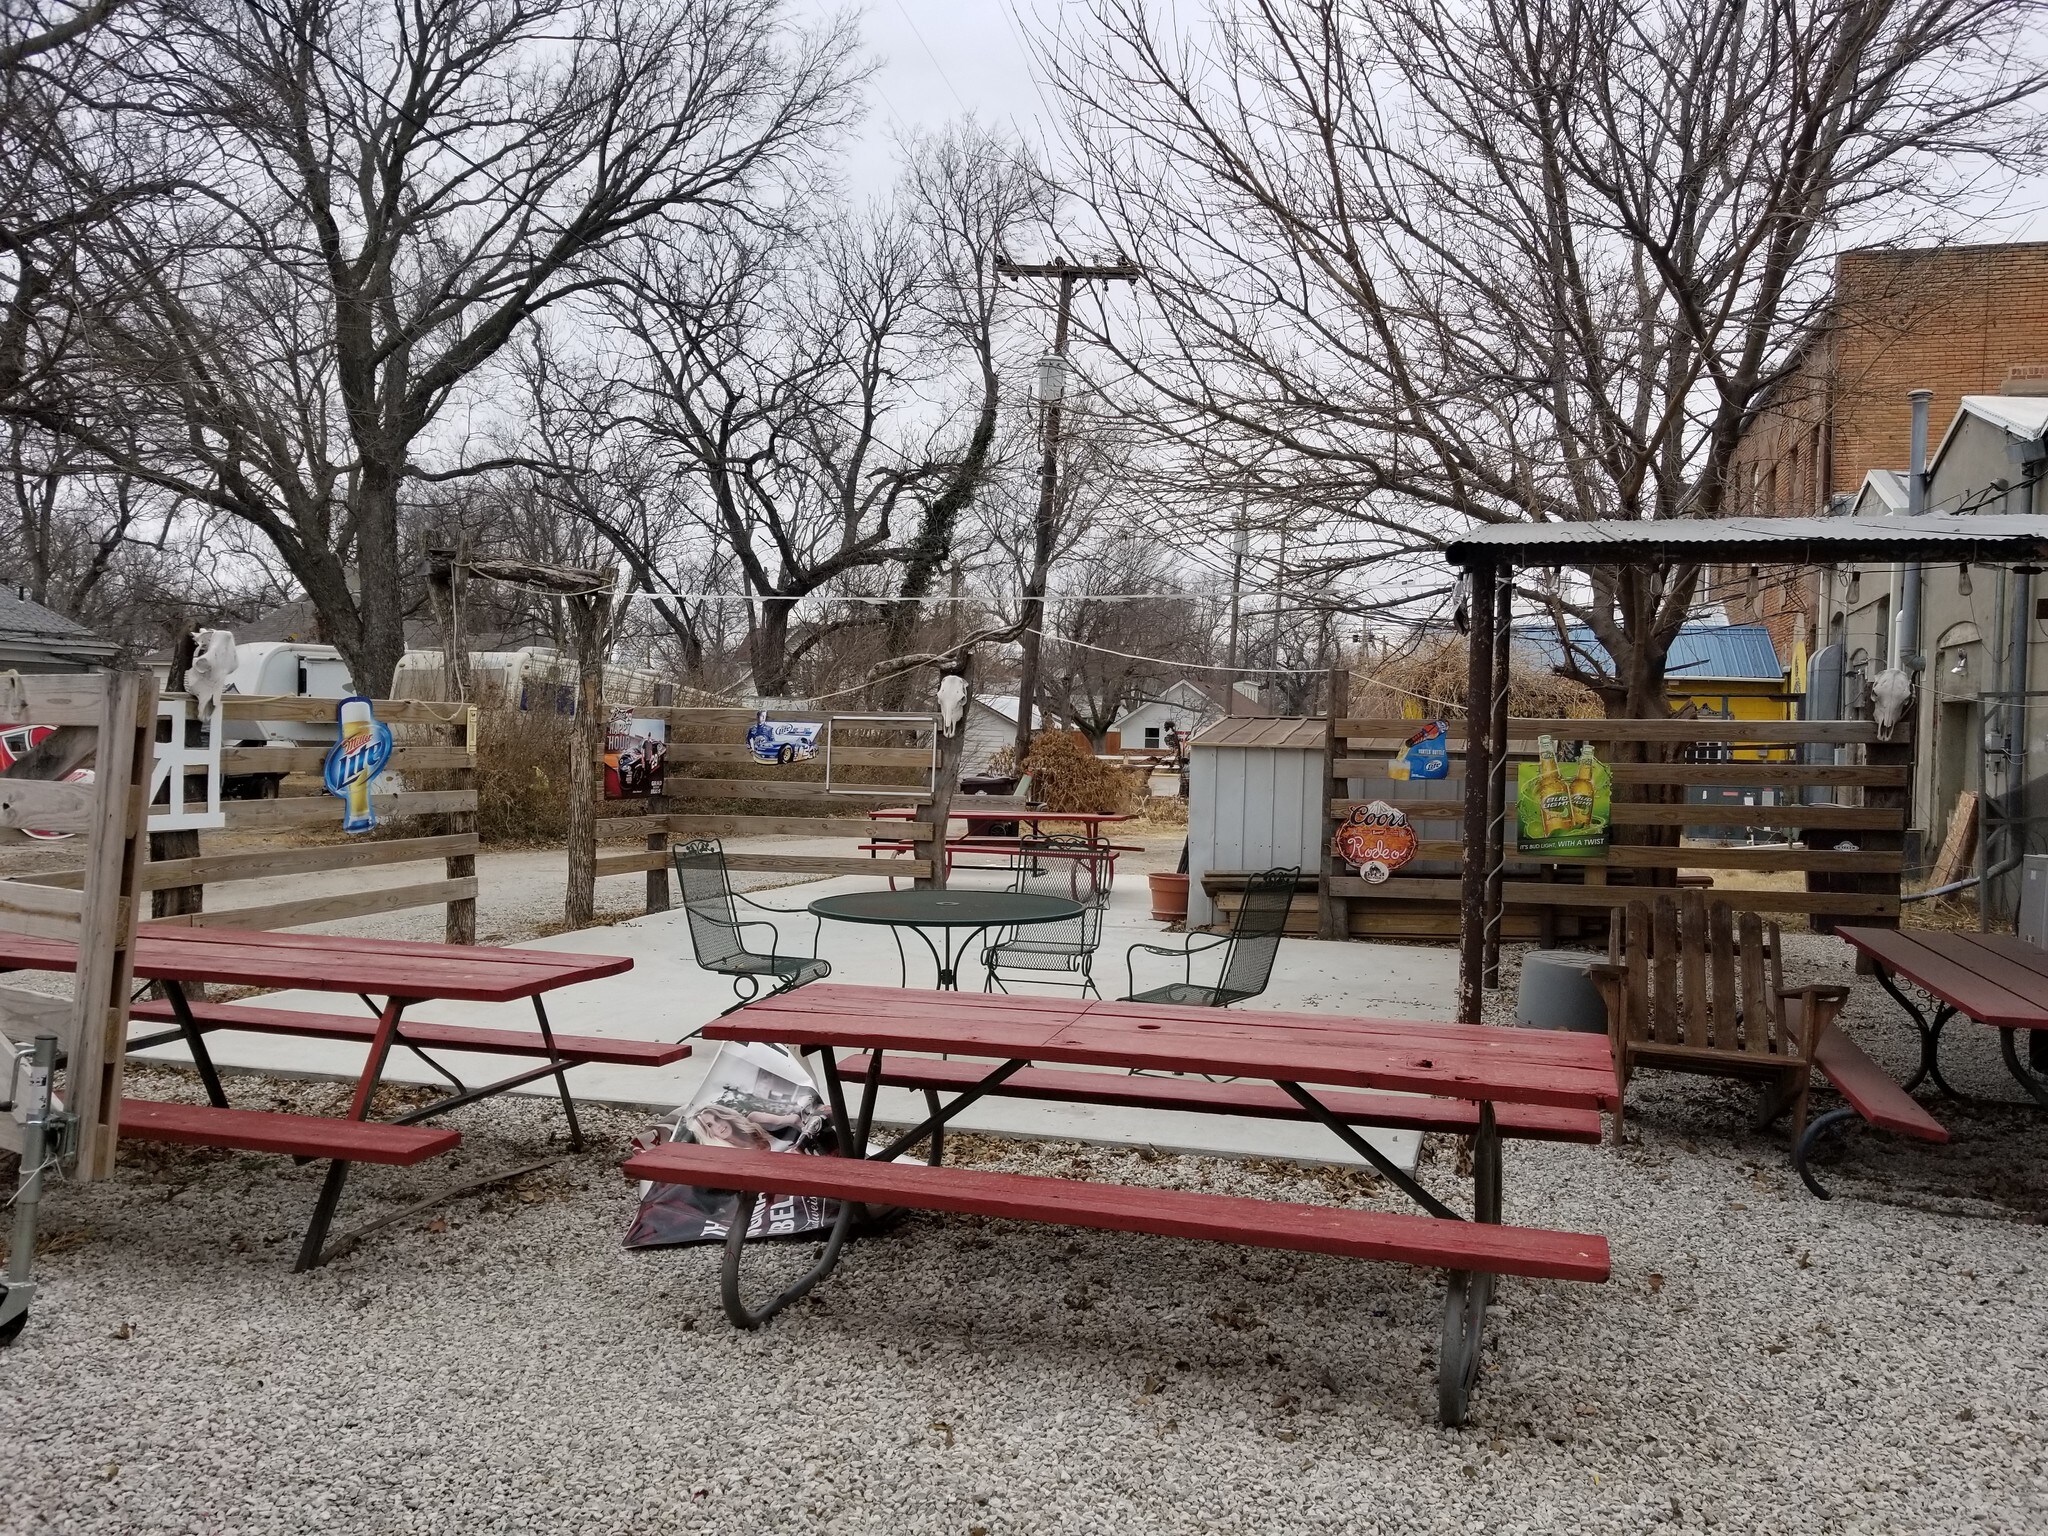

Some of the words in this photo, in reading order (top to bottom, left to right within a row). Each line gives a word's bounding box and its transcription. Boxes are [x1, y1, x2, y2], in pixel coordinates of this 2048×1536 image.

[609, 722, 631, 736] HAPPY
[341, 734, 373, 755] Miller
[607, 735, 631, 751] HOUR
[336, 741, 381, 791] Lite
[1543, 801, 1570, 809] LIGHT
[1350, 806, 1406, 827] Coors
[1348, 836, 1407, 859] Rodeo
[1584, 838, 1605, 846] TWIST
